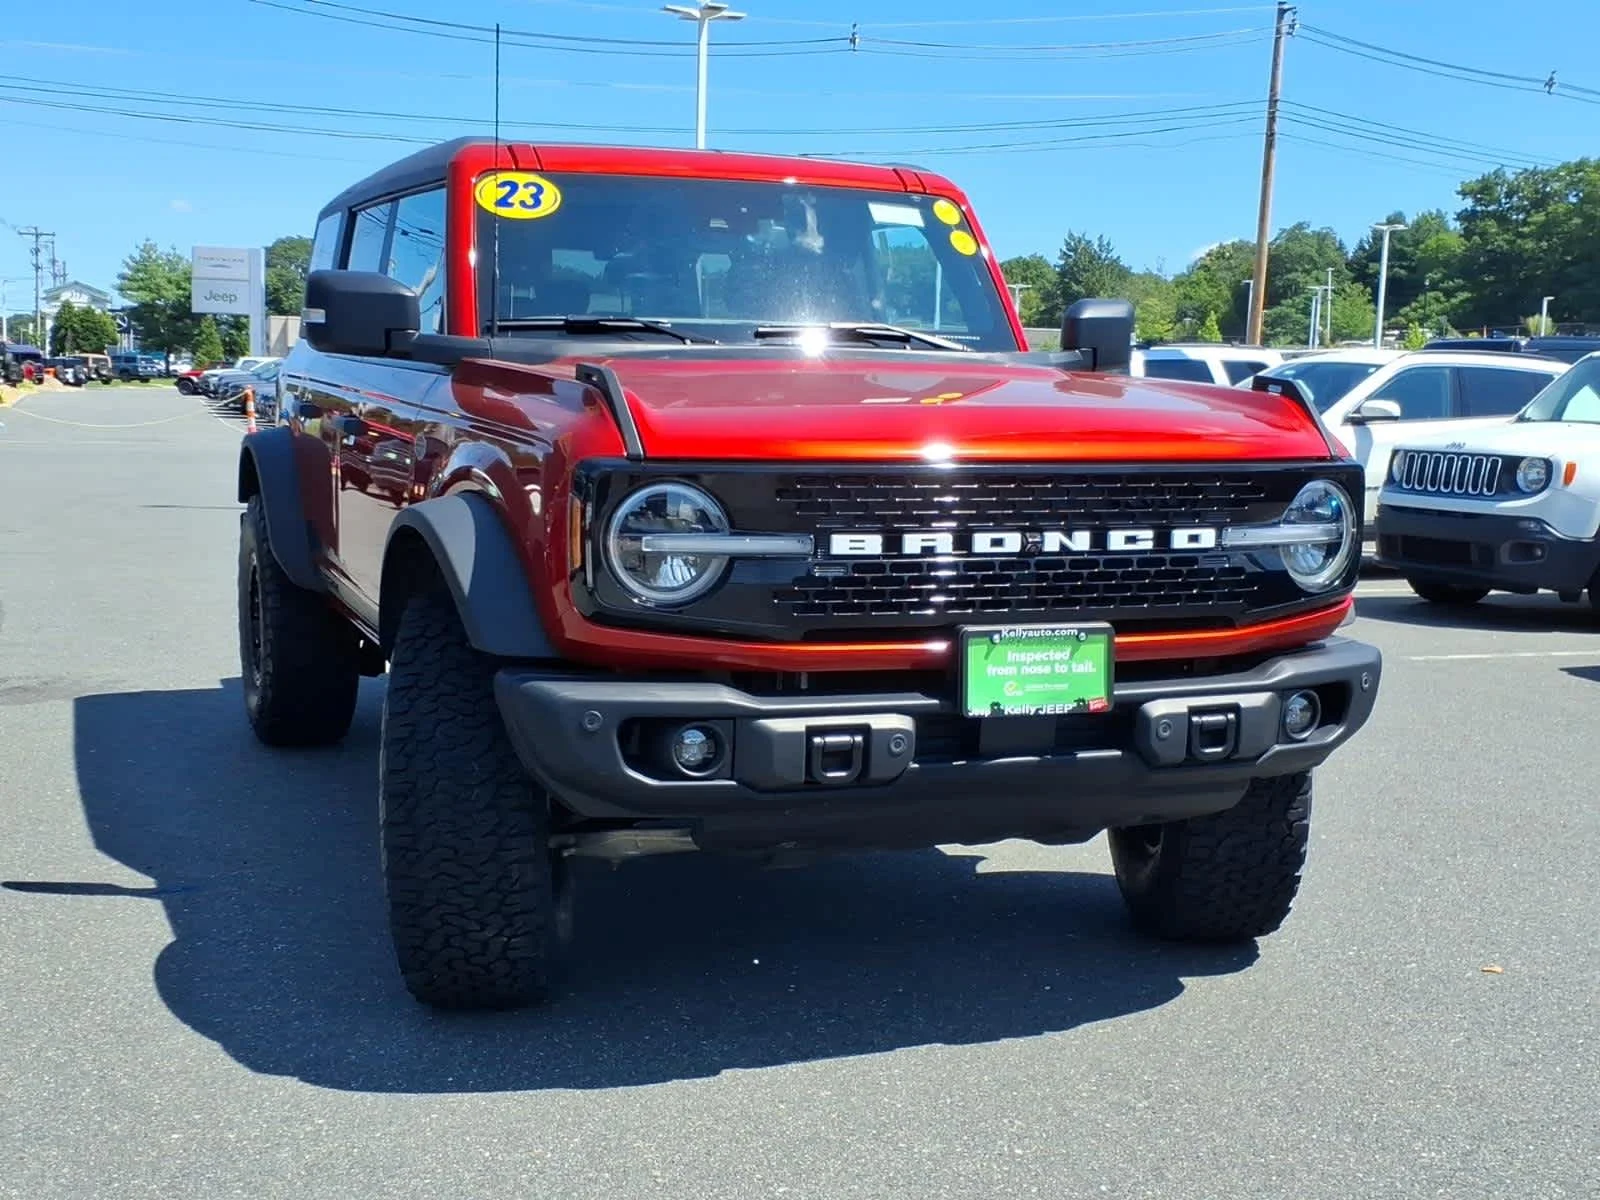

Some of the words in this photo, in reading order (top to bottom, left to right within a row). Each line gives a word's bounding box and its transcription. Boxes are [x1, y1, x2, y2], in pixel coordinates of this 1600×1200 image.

[494, 180, 545, 209] 23
[203, 289, 238, 304] Jeep
[830, 528, 1216, 555] BRONCO
[1001, 628, 1078, 638] Kellyauto.com
[1008, 648, 1071, 664] Inspected
[987, 663, 1017, 676] from
[1021, 665, 1052, 674] nose
[1055, 662, 1069, 673] to
[1072, 660, 1097, 673] tail.
[1004, 703, 1037, 715] Kelly
